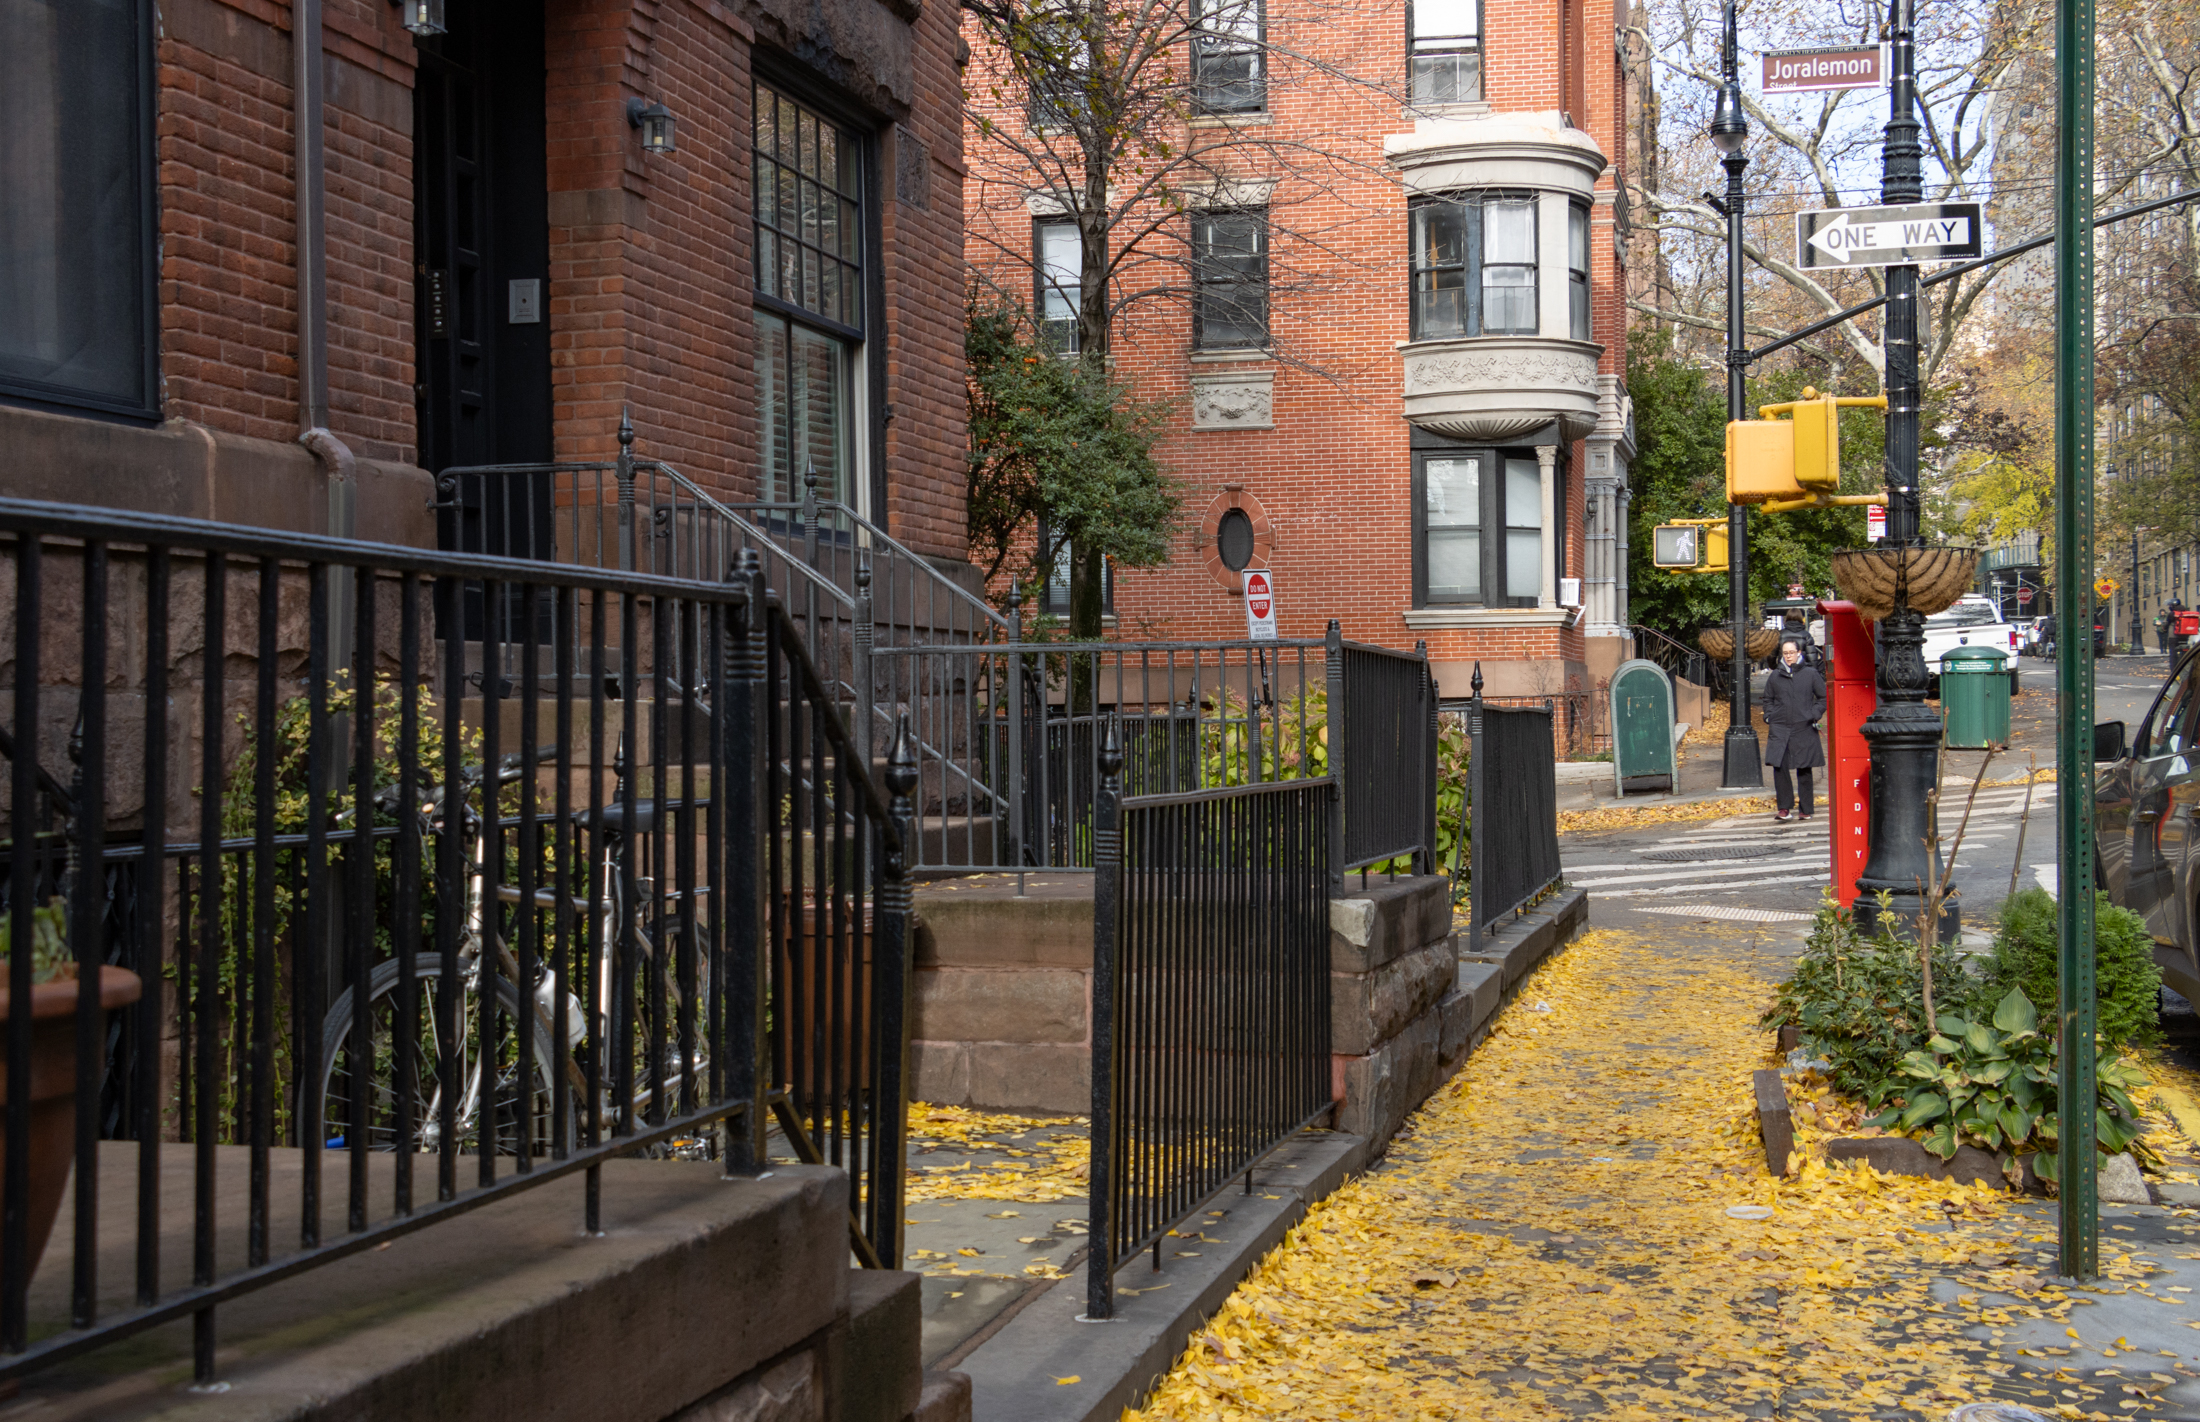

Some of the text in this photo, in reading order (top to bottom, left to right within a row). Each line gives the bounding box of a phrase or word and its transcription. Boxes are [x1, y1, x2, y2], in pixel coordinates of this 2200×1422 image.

[1769, 57, 1872, 80] Joralemon
[1769, 81, 1798, 89] Street
[1827, 221, 1957, 249] ONE WAY
[1250, 584, 1267, 593] DO NOT
[1252, 602, 1268, 610] ENTER
[1853, 778, 1862, 859] FDNY
